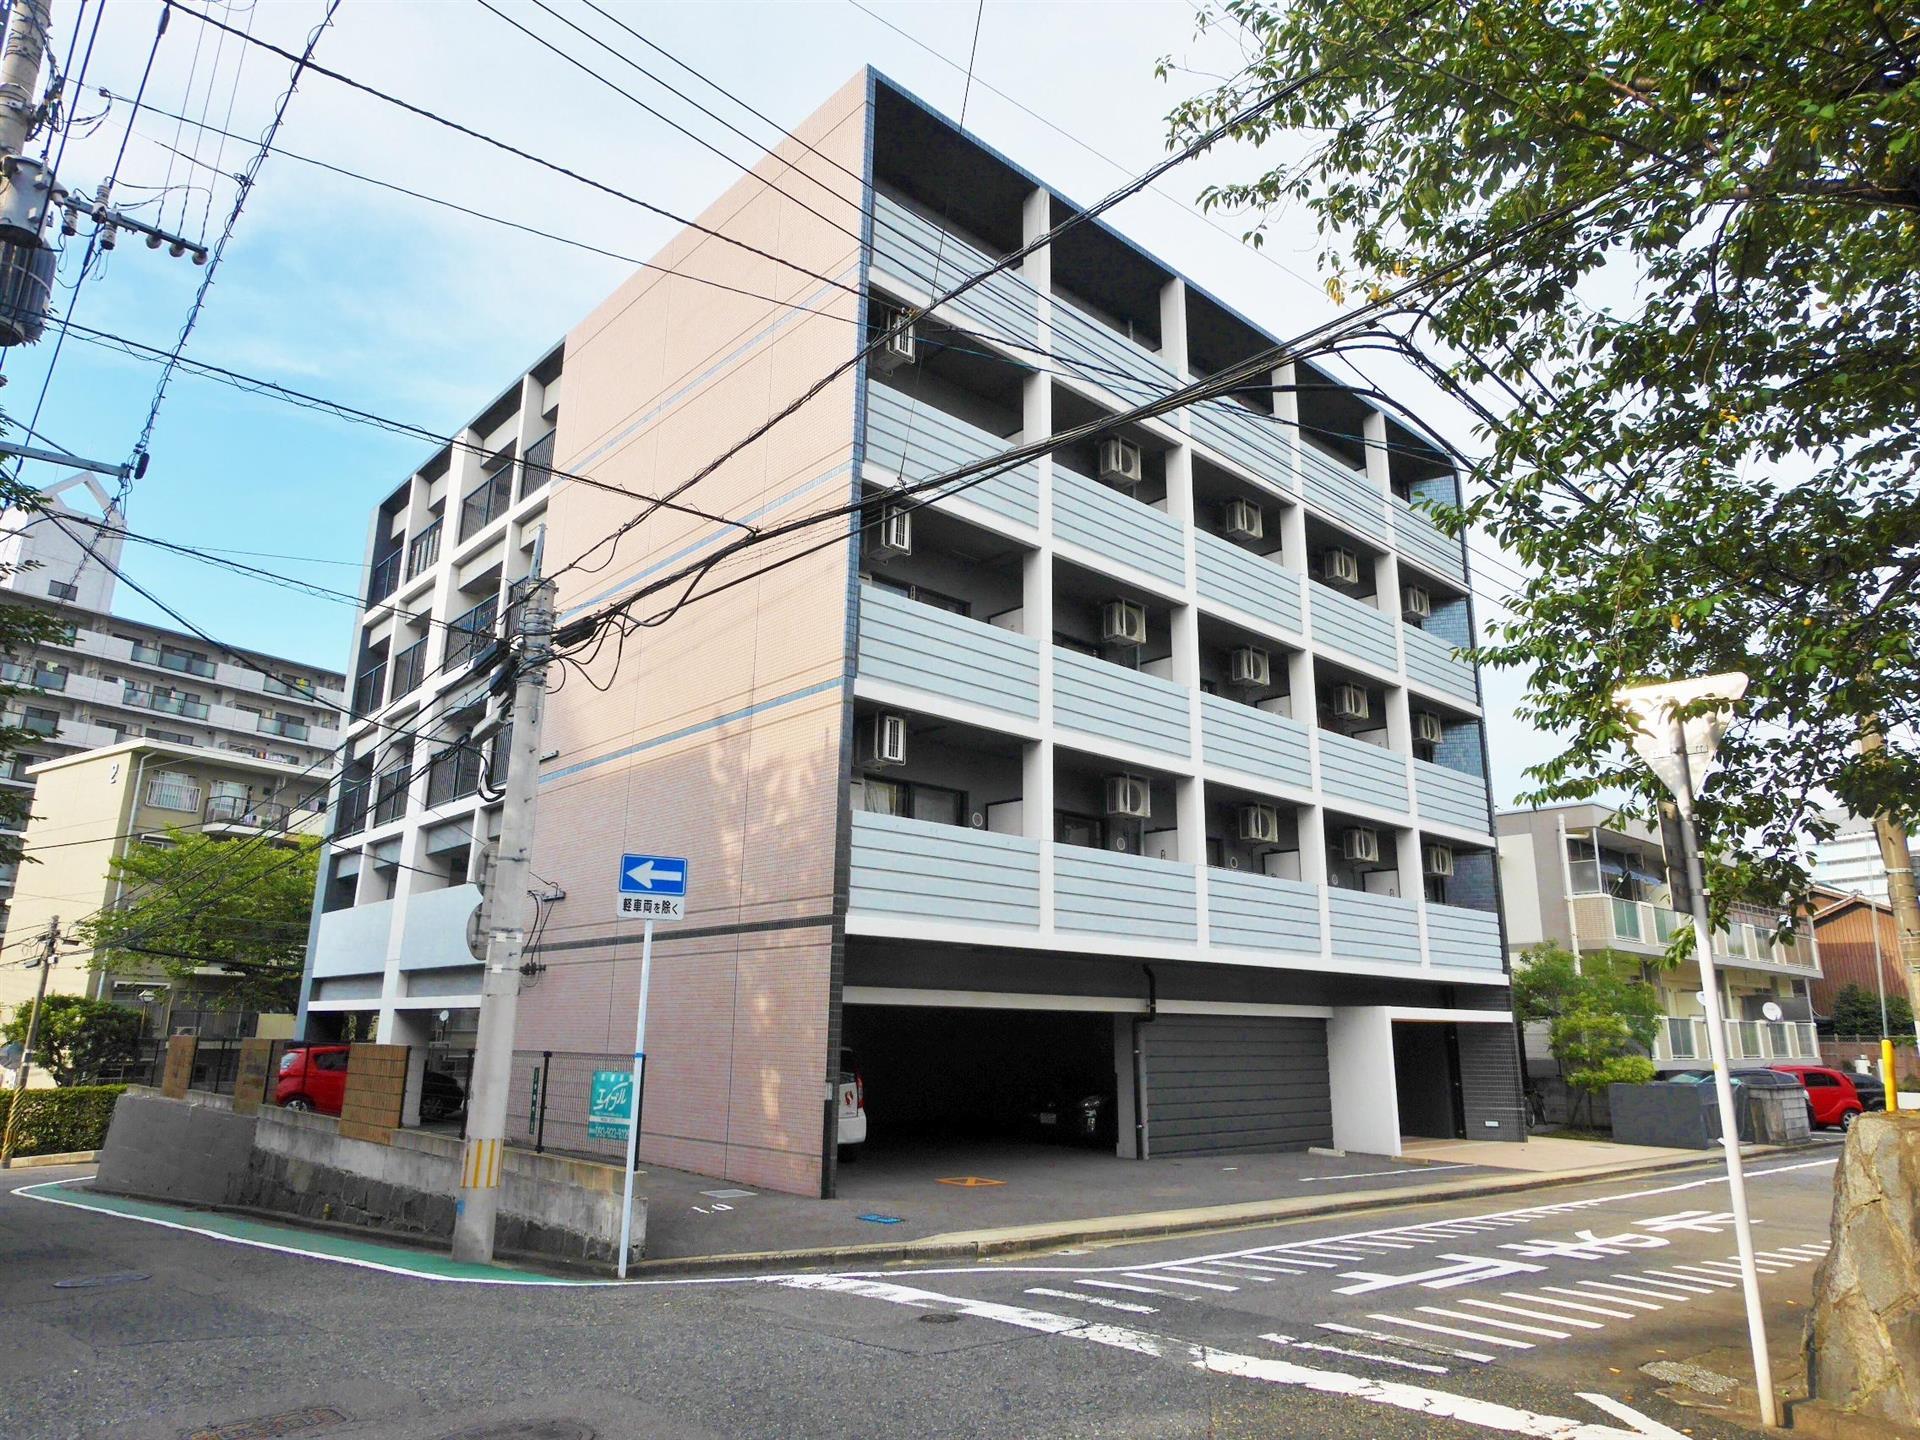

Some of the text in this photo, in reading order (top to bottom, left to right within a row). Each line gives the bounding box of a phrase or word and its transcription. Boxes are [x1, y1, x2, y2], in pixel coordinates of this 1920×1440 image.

[623, 898, 678, 915] 軽車両を除く
[593, 1082, 629, 1111] エイブル
[1332, 1211, 1765, 1296] 止まれ
